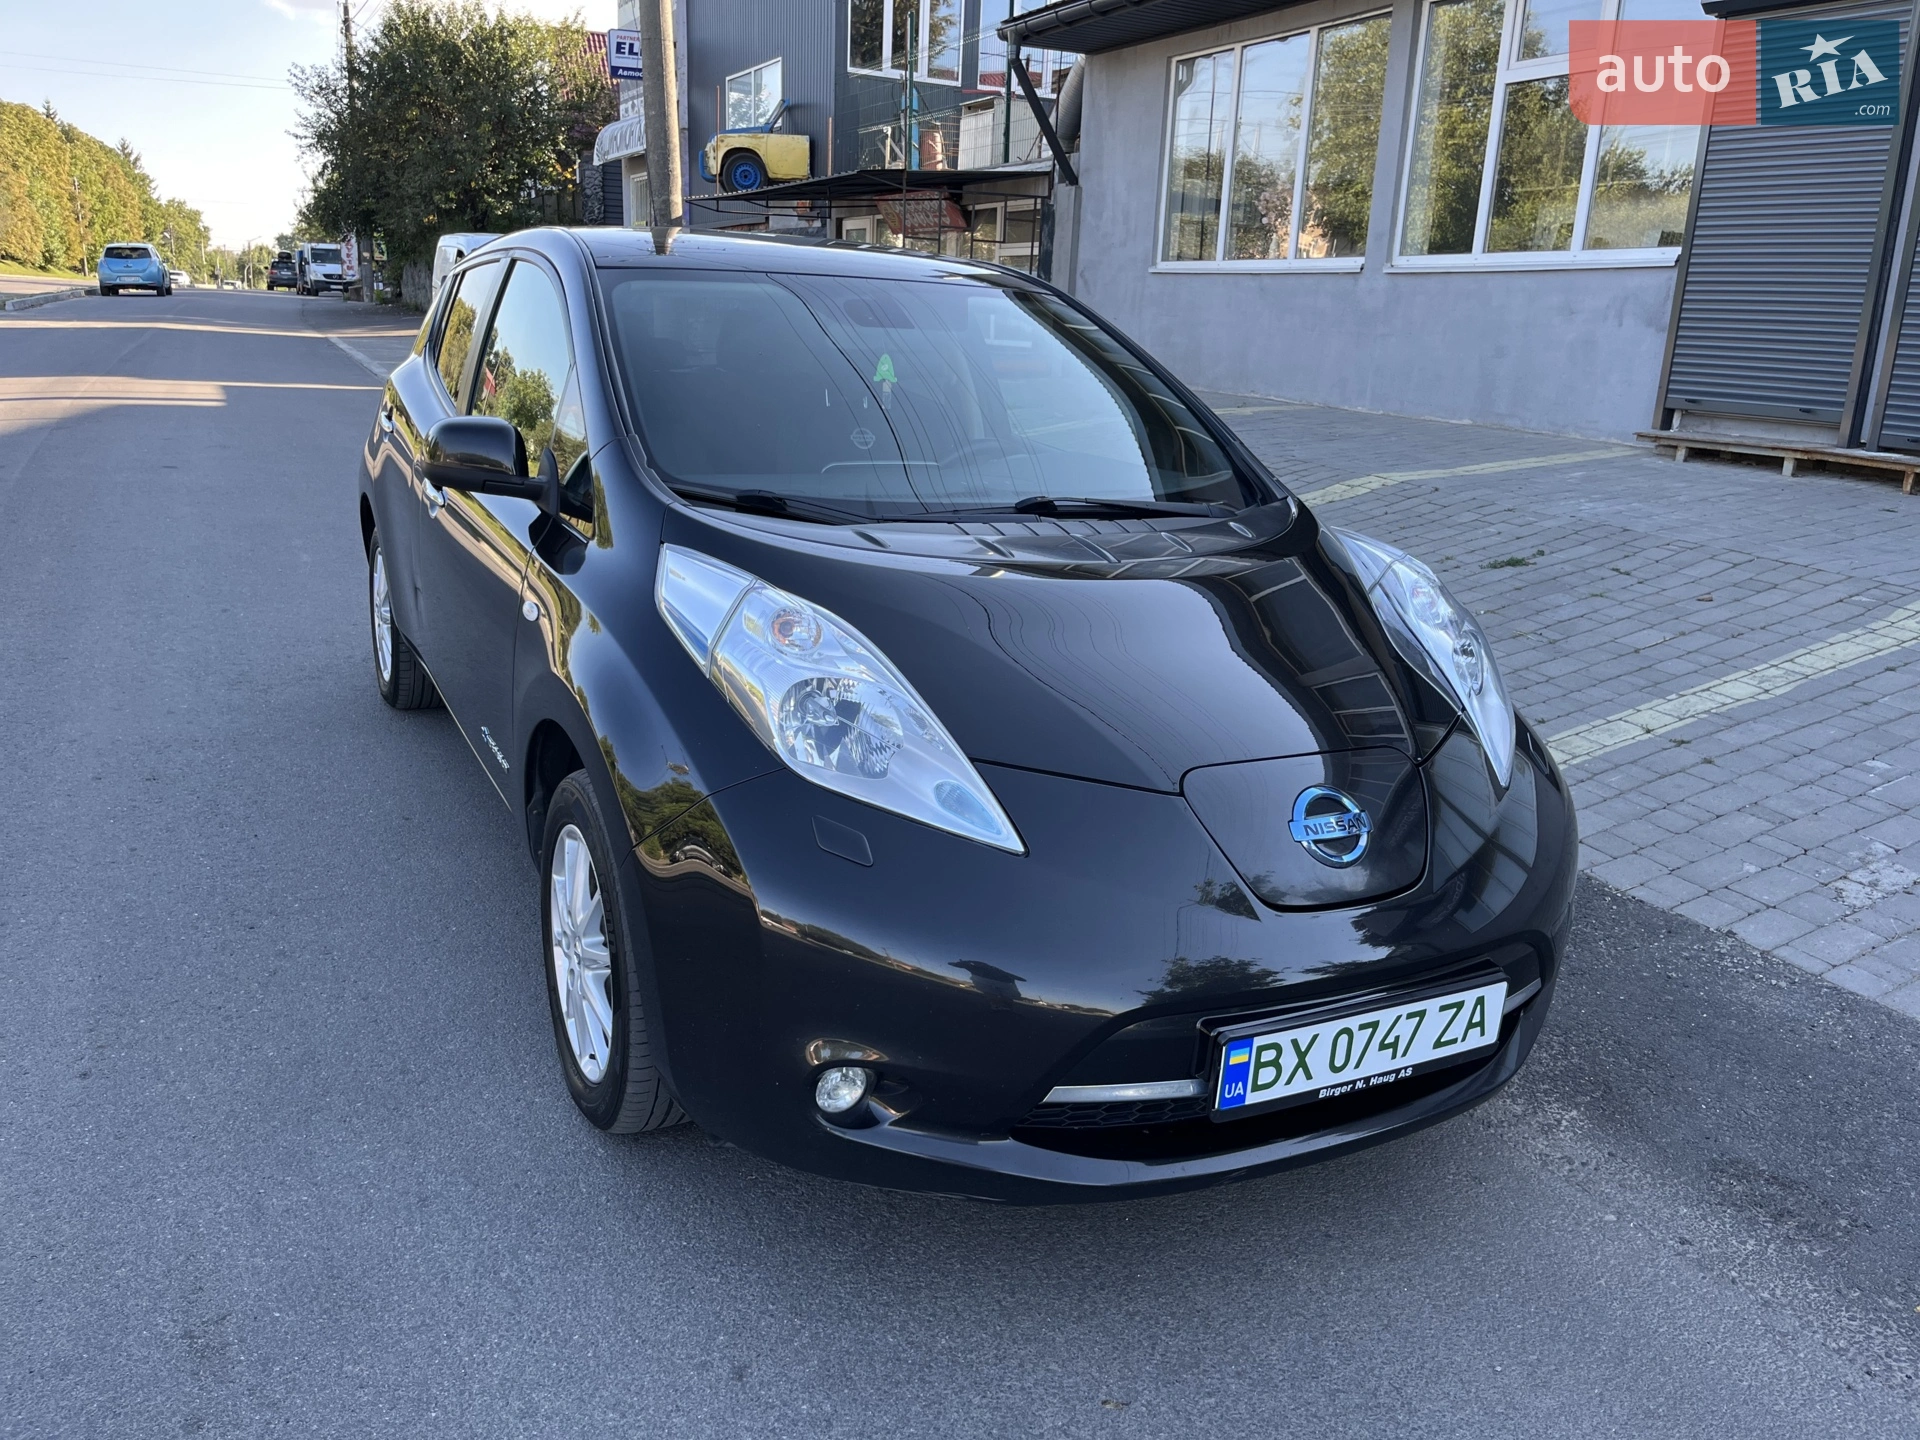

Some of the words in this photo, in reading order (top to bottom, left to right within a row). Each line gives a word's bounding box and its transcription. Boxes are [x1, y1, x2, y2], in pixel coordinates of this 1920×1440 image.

[615, 42, 642, 56] EL
[1303, 814, 1367, 836] NISSAN
[1250, 1033, 1320, 1093] BX
[1328, 1008, 1427, 1074] 0747
[1432, 995, 1486, 1050] ZA
[1224, 1082, 1244, 1099] UA
[1318, 1083, 1353, 1099] Birger
[1355, 1079, 1366, 1090] N.
[1369, 1073, 1396, 1086] Haug
[1398, 1067, 1413, 1079] AS
